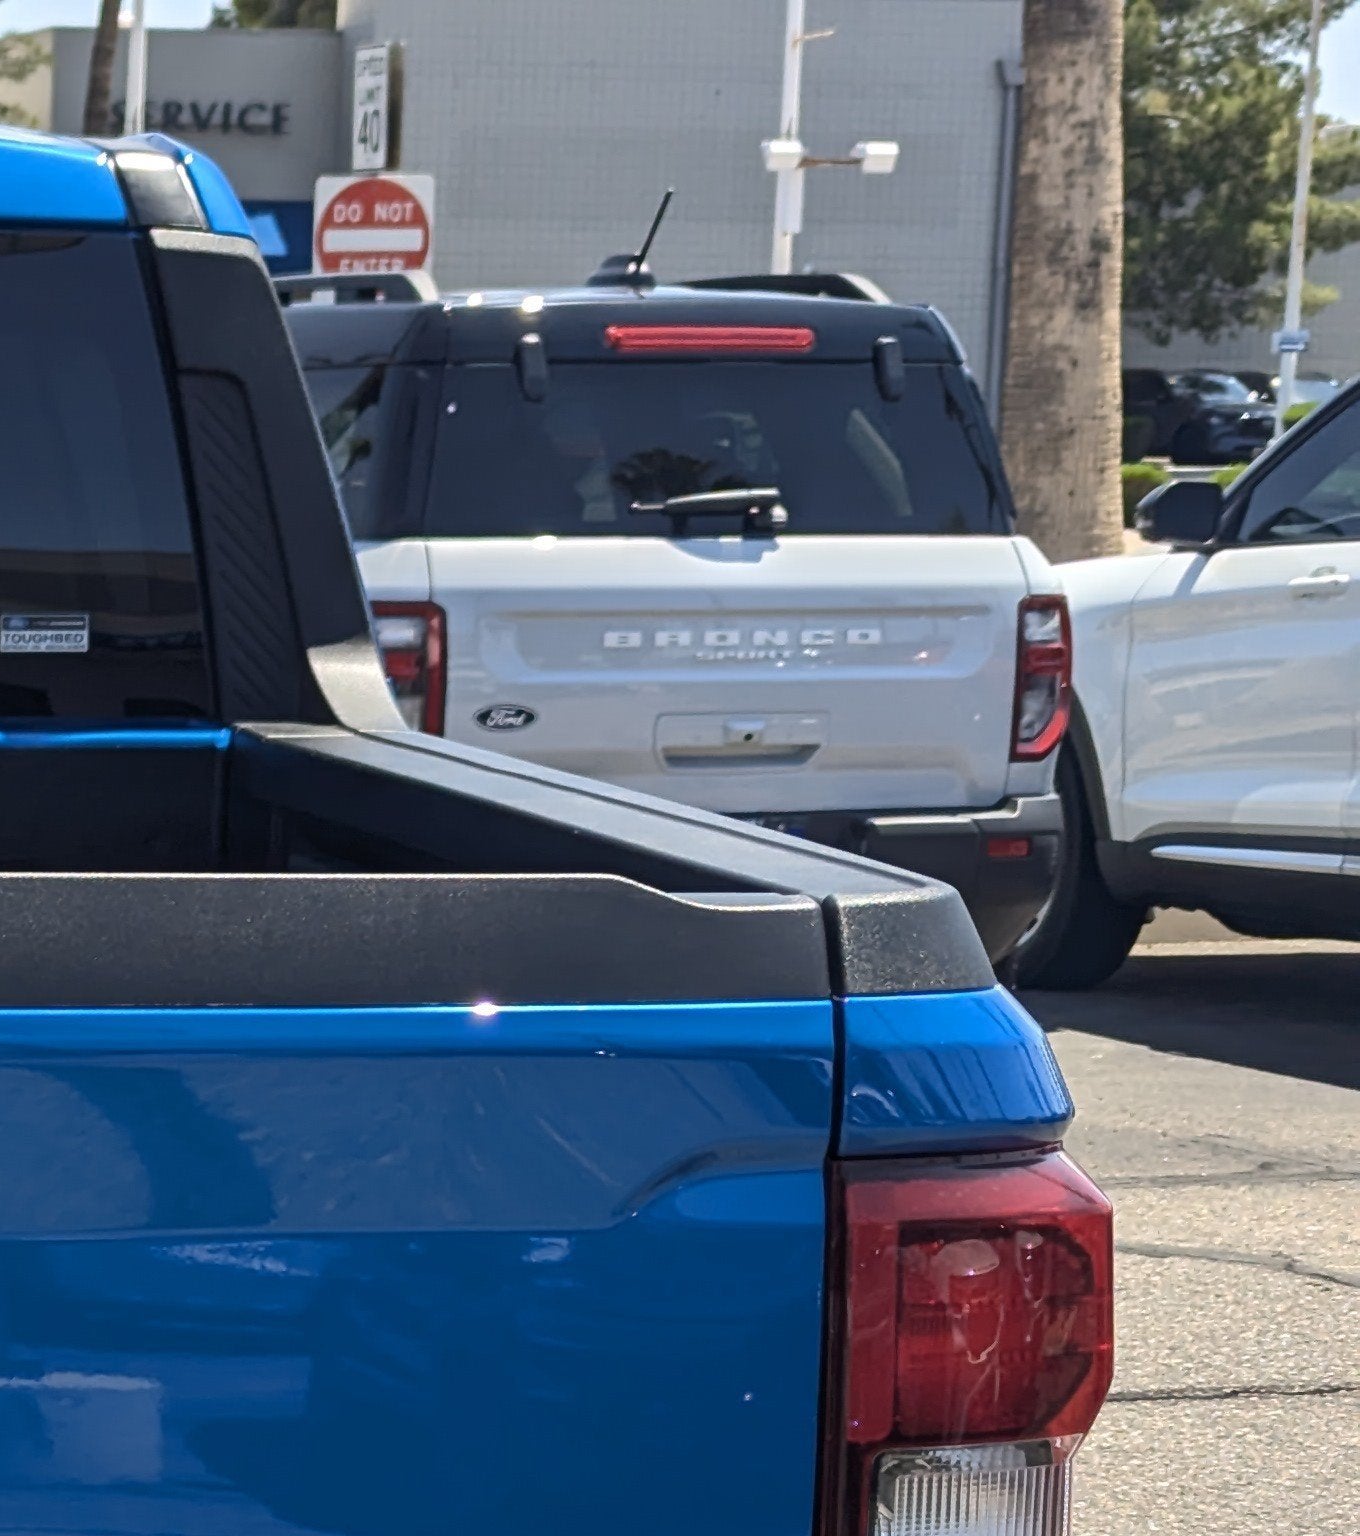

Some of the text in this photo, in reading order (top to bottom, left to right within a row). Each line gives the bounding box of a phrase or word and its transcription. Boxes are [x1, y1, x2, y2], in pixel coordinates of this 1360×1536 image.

[358, 108, 380, 153] 40
[333, 202, 414, 223] DO NOT
[3, 633, 84, 643] TOUGHBED
[603, 629, 882, 648] BRONCO
[487, 709, 526, 727] Ford
